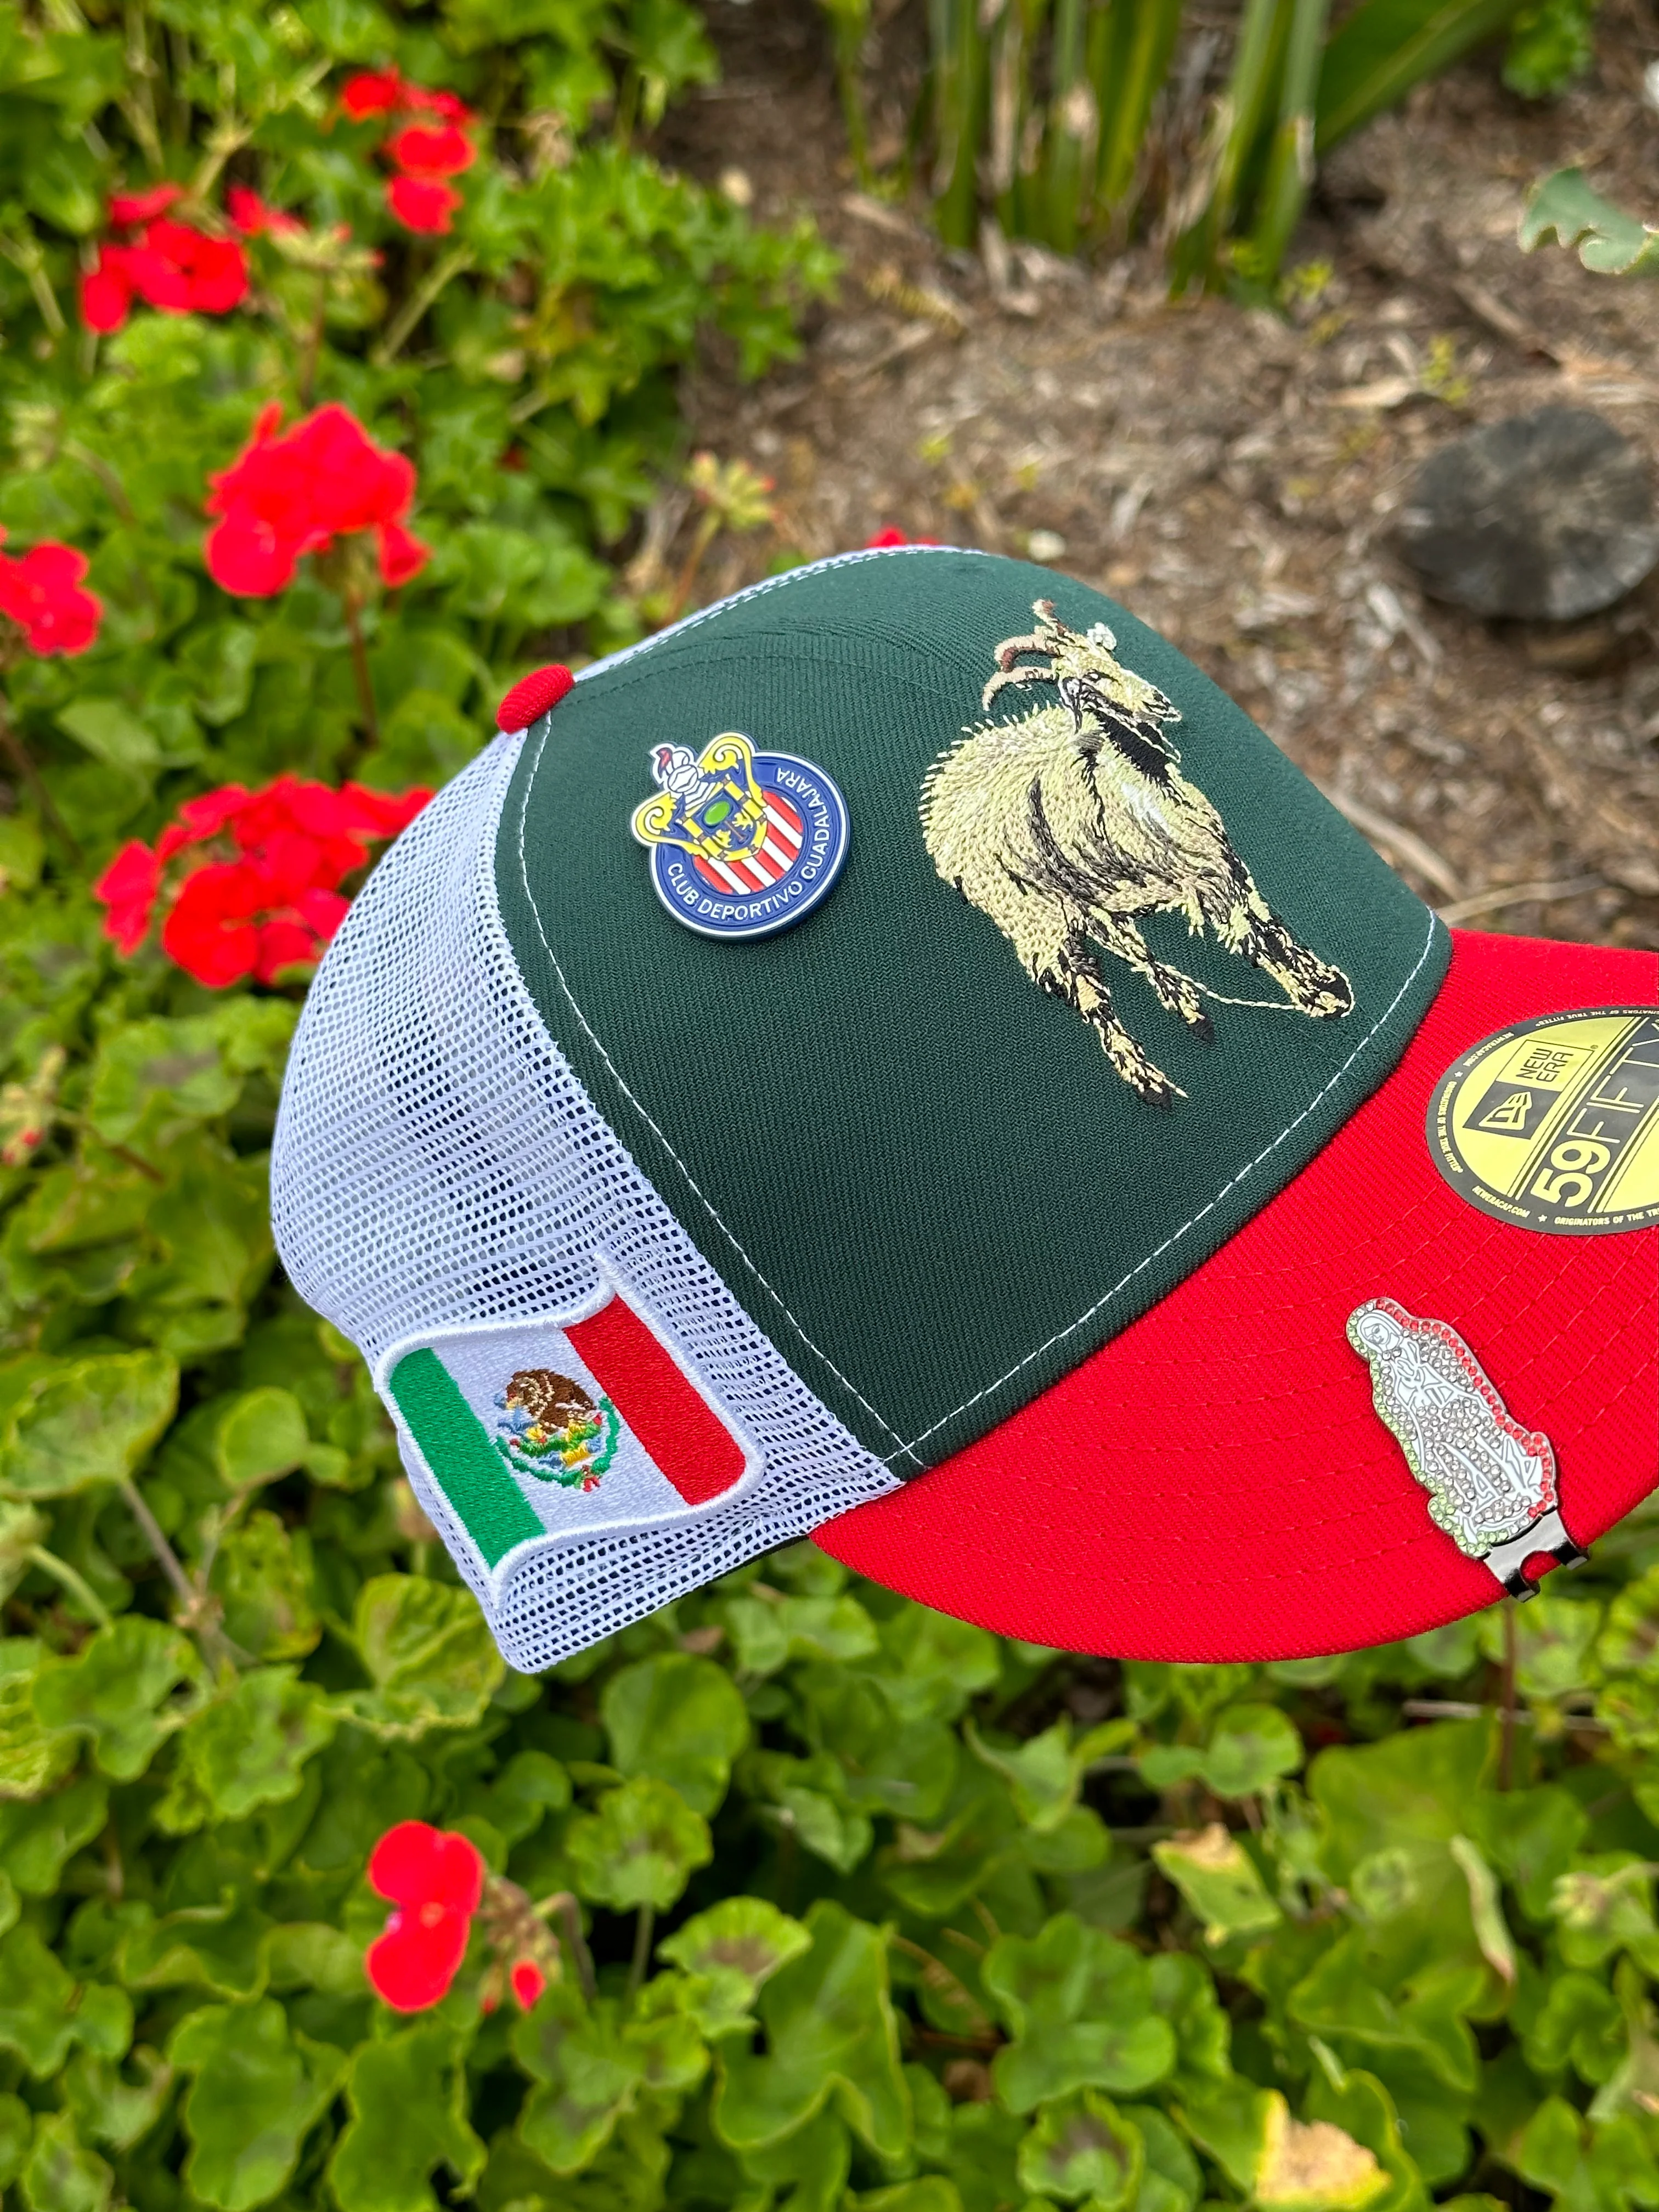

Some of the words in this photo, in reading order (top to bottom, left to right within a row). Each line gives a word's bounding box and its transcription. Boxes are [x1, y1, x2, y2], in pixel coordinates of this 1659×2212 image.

[668, 863, 699, 907] CLUB
[698, 881, 803, 920] DEPORTIVO
[776, 766, 830, 879] GUADALAJARA
[1515, 1047, 1553, 1080] NEW
[1536, 1051, 1574, 1083] ERA
[1437, 1125, 1447, 1137] THE
[1471, 1185, 1531, 1218] NEWERACAP.COM
[1554, 1216, 1610, 1226] ORIGINATORS
[1612, 1215, 1624, 1224] OF
[1627, 1211, 1645, 1221] THE
